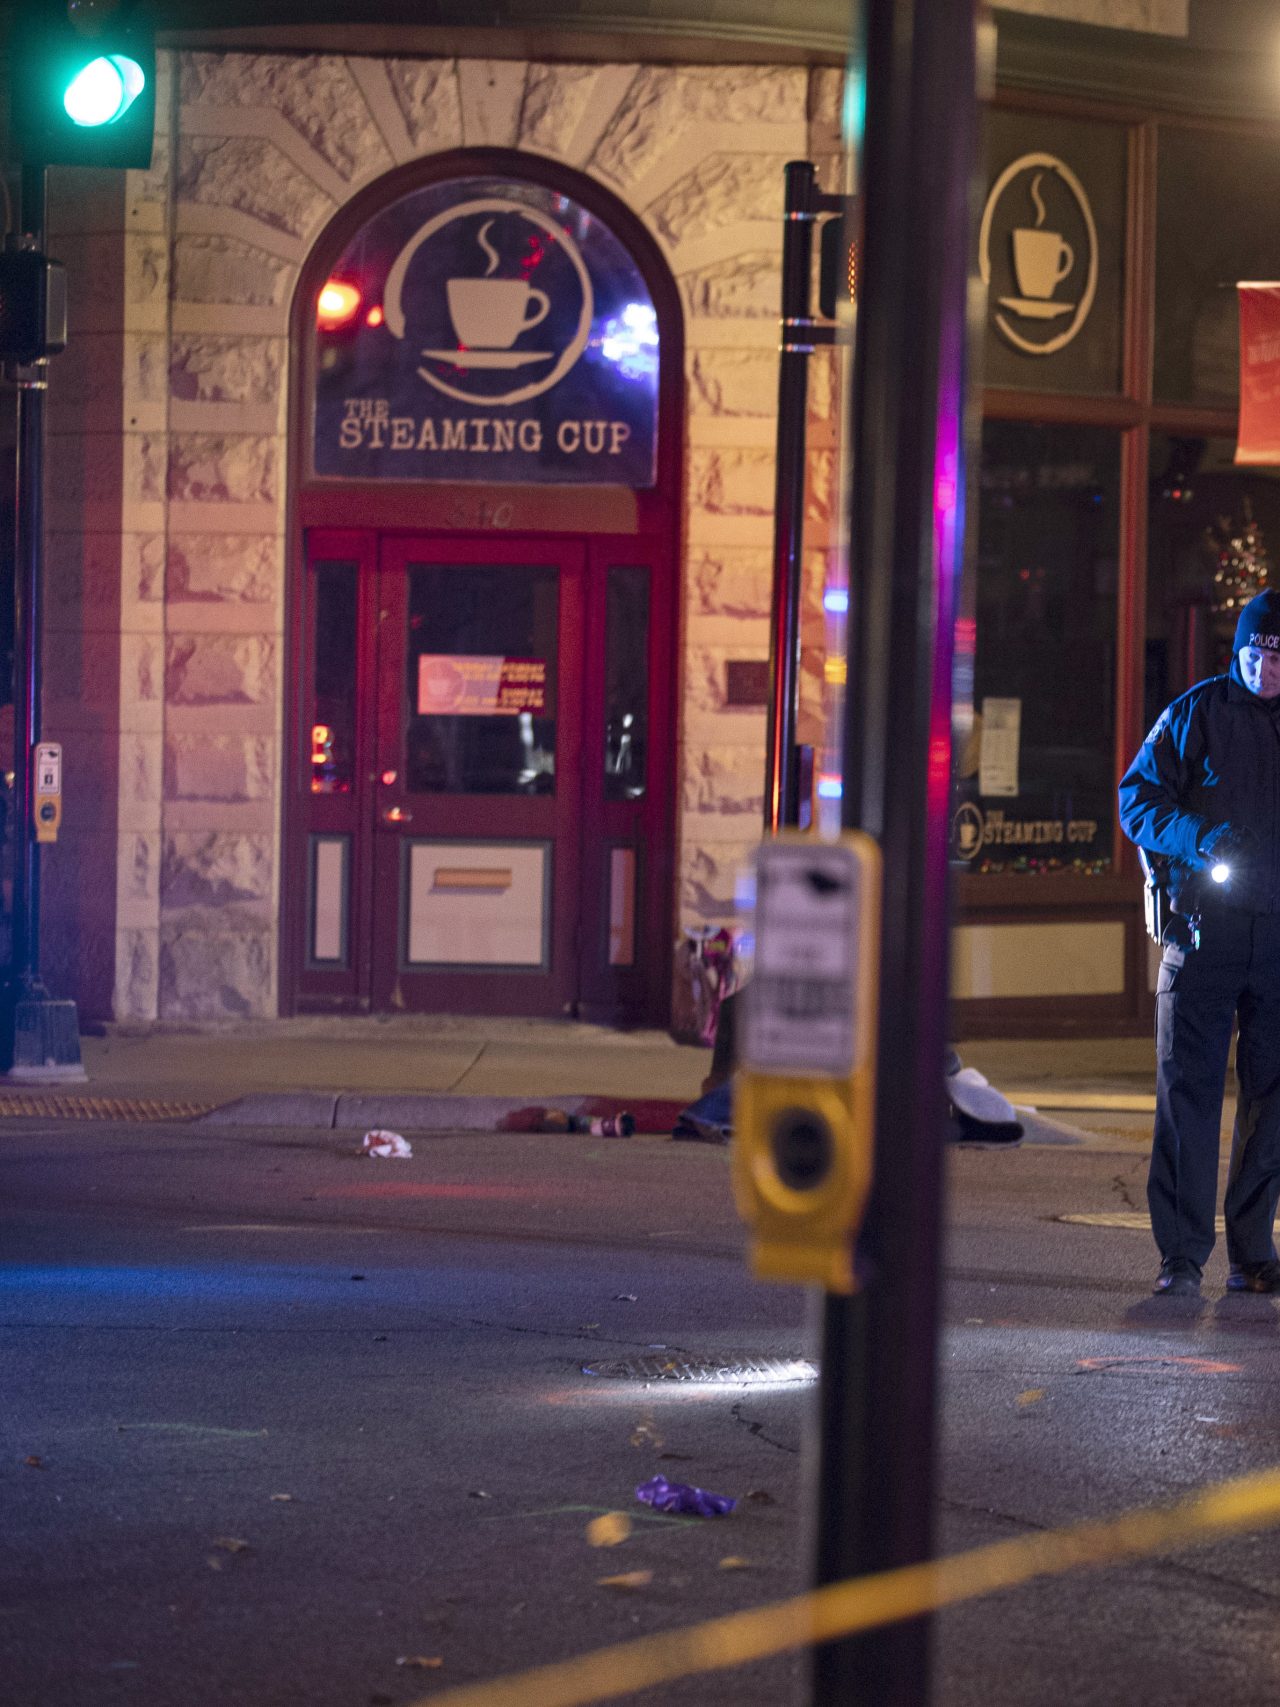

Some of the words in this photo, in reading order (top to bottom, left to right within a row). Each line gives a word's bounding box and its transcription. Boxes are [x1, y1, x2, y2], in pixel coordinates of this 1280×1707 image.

[344, 399, 389, 420] THE
[339, 416, 543, 453] STEAMING
[557, 421, 632, 454] CUP
[1249, 632, 1280, 649] POLICE
[983, 819, 1064, 844] STEAMING
